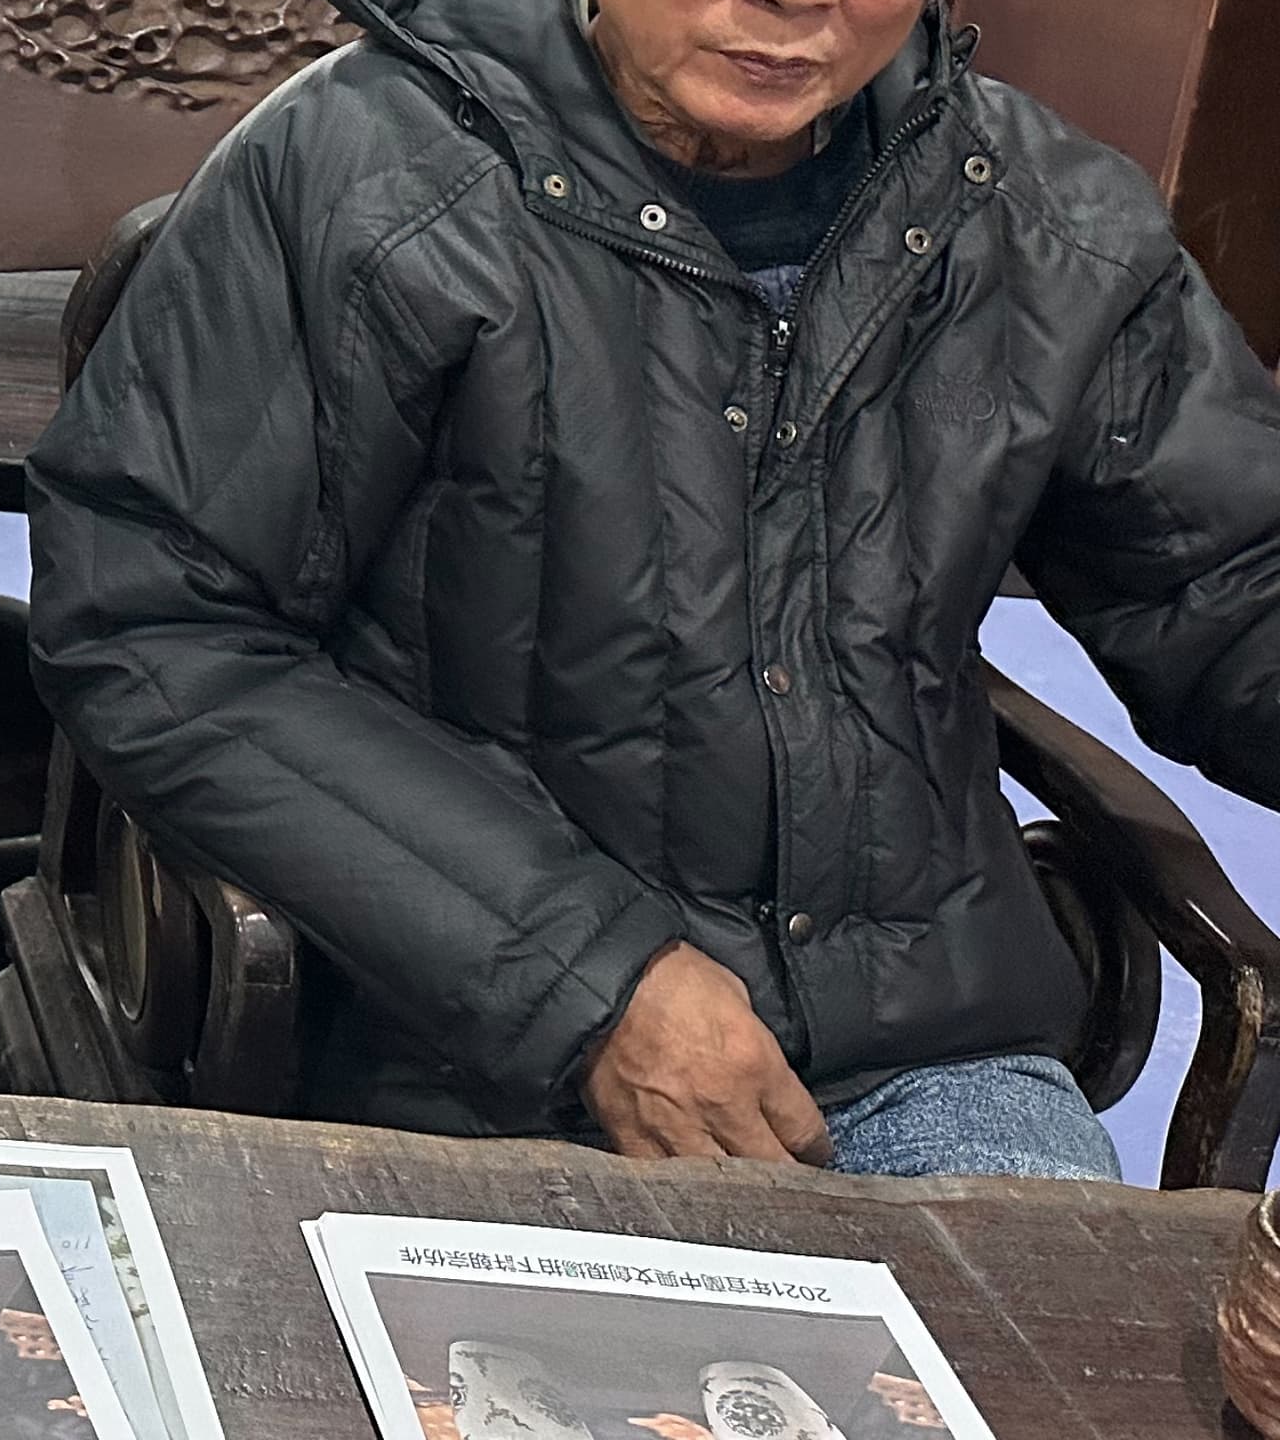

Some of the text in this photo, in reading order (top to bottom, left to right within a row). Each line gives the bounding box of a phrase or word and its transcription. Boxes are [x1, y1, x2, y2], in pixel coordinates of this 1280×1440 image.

[399, 1246, 832, 1304] 2021年宜蘭中興文創現場拍下許朝宗仿作
